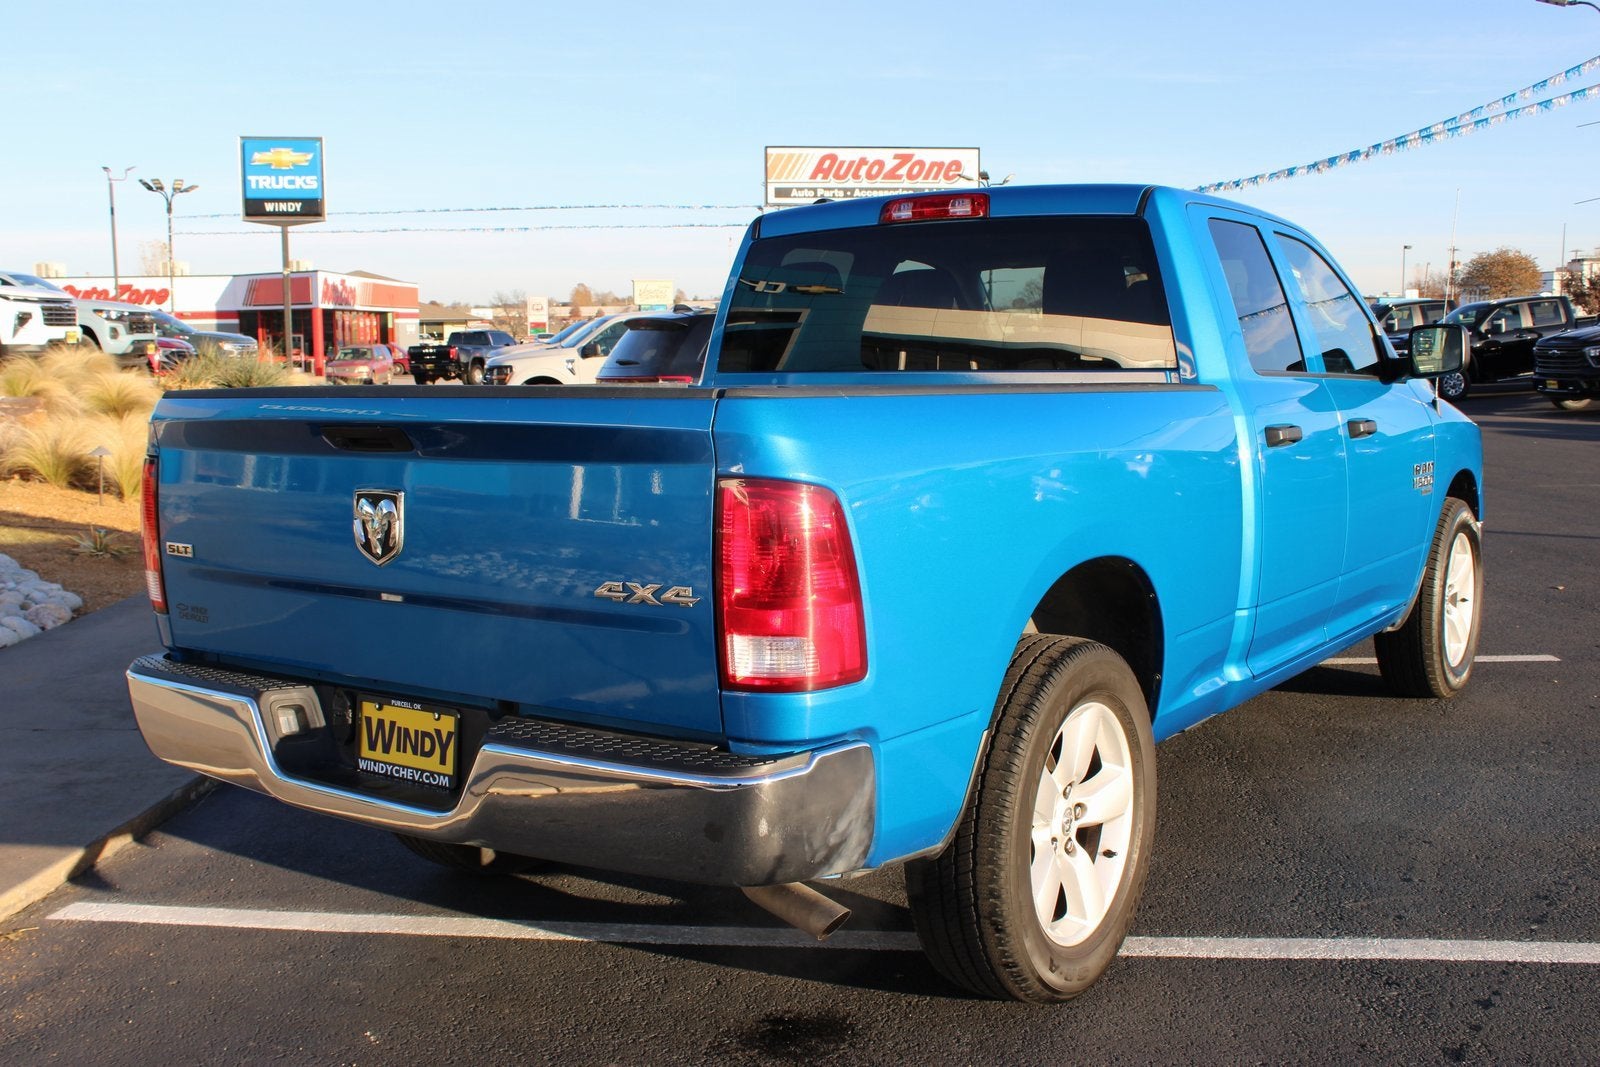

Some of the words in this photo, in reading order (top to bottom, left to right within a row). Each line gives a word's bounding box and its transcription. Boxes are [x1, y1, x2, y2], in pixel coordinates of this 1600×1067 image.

[809, 153, 963, 182] AutoZone
[247, 175, 318, 190] TRUCKS
[790, 188, 815, 198] Auto
[817, 188, 845, 198] Parts
[264, 202, 302, 212] WINDY
[168, 544, 190, 555] SLT
[413, 703, 422, 711] OK
[364, 715, 455, 766] WINDY
[358, 758, 450, 787] WINDYCHEV.COM
